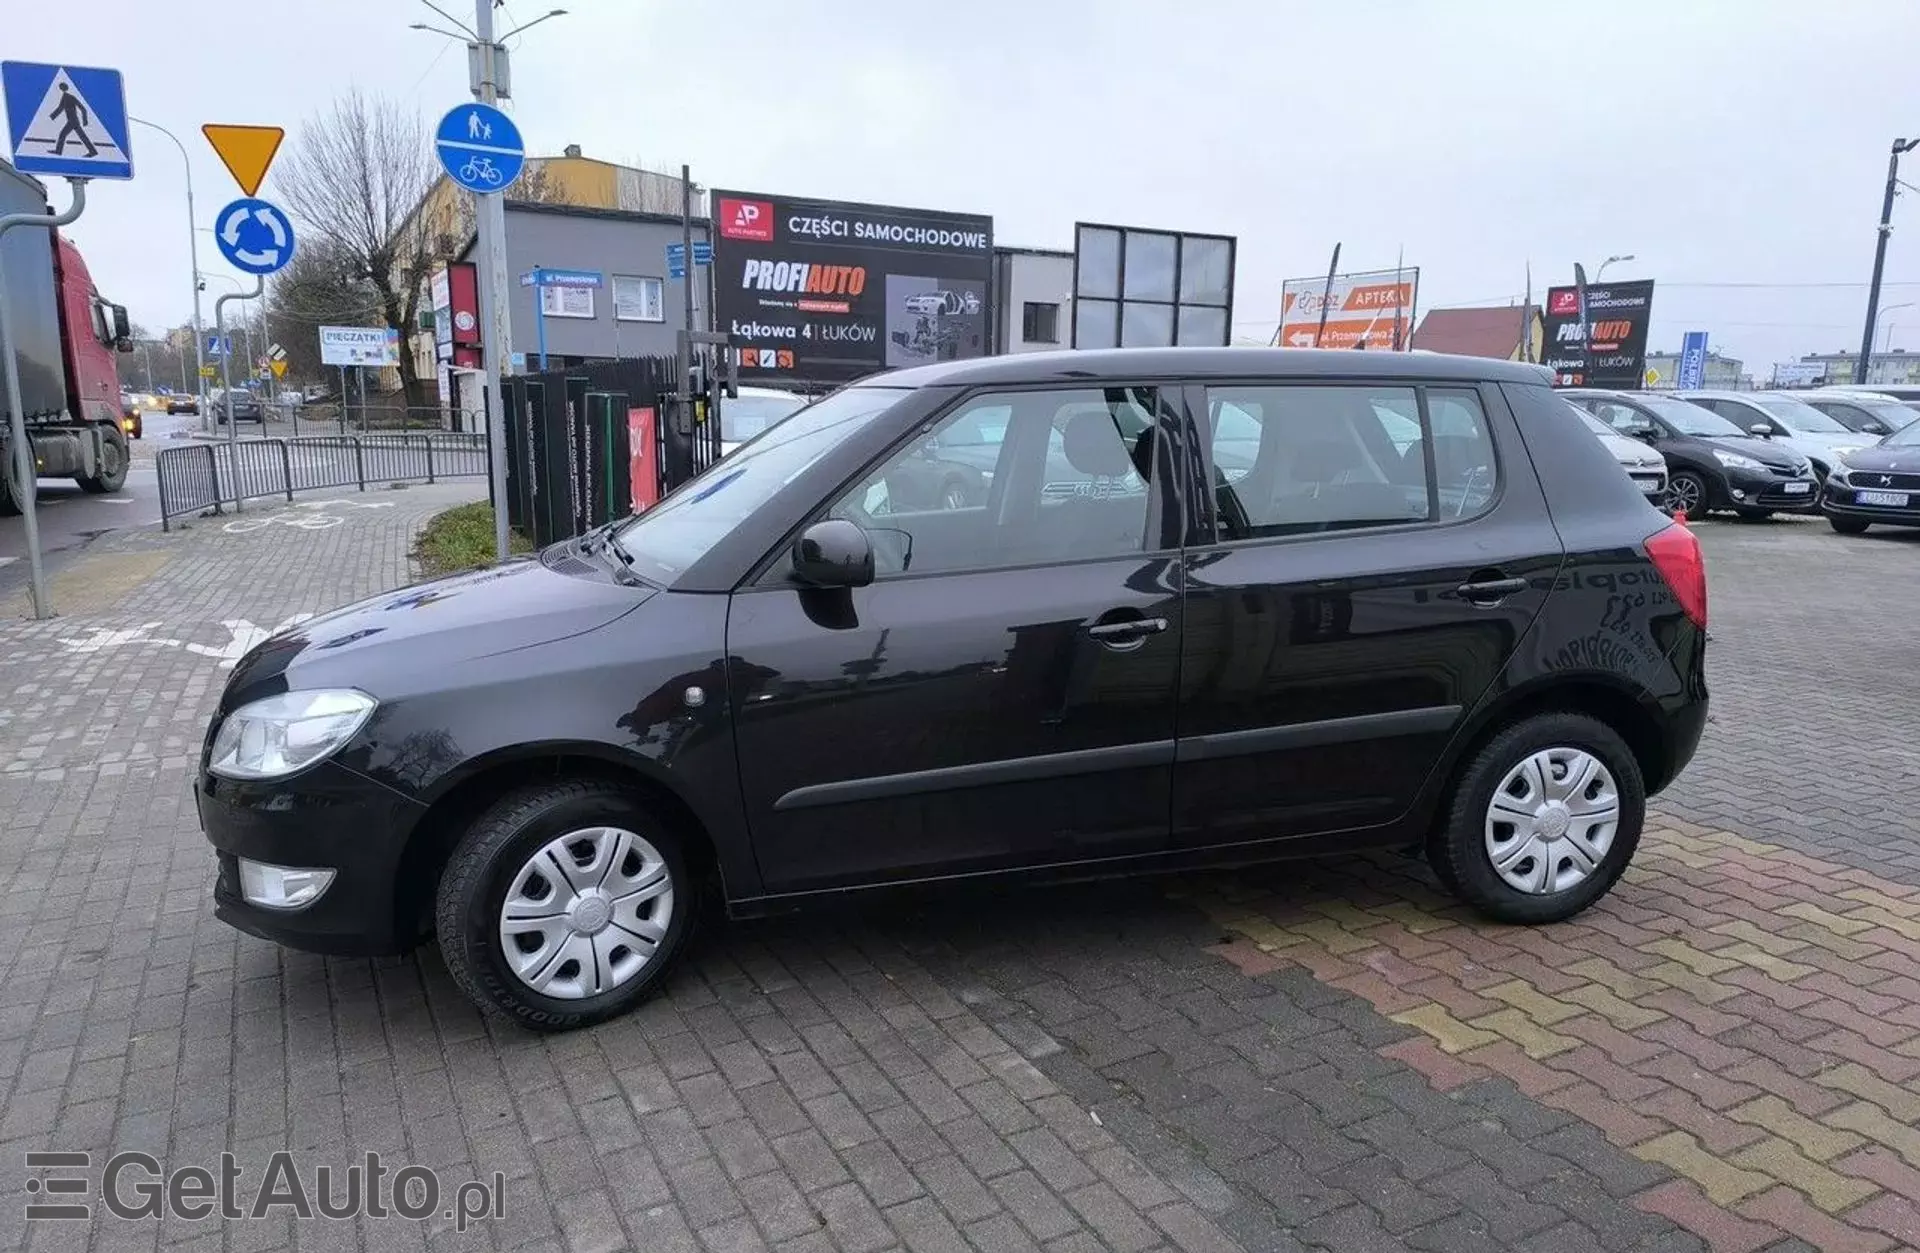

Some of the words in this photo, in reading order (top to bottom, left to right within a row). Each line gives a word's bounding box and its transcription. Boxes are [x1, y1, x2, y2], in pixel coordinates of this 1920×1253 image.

[788, 215, 849, 239] CZĘŚCI
[854, 221, 987, 249] SAMOCHODOWE
[742, 258, 867, 296] PROFIAUTO
[731, 320, 796, 341] Łąkowa
[802, 326, 812, 339] 4
[822, 322, 877, 342] ŁUKÓW
